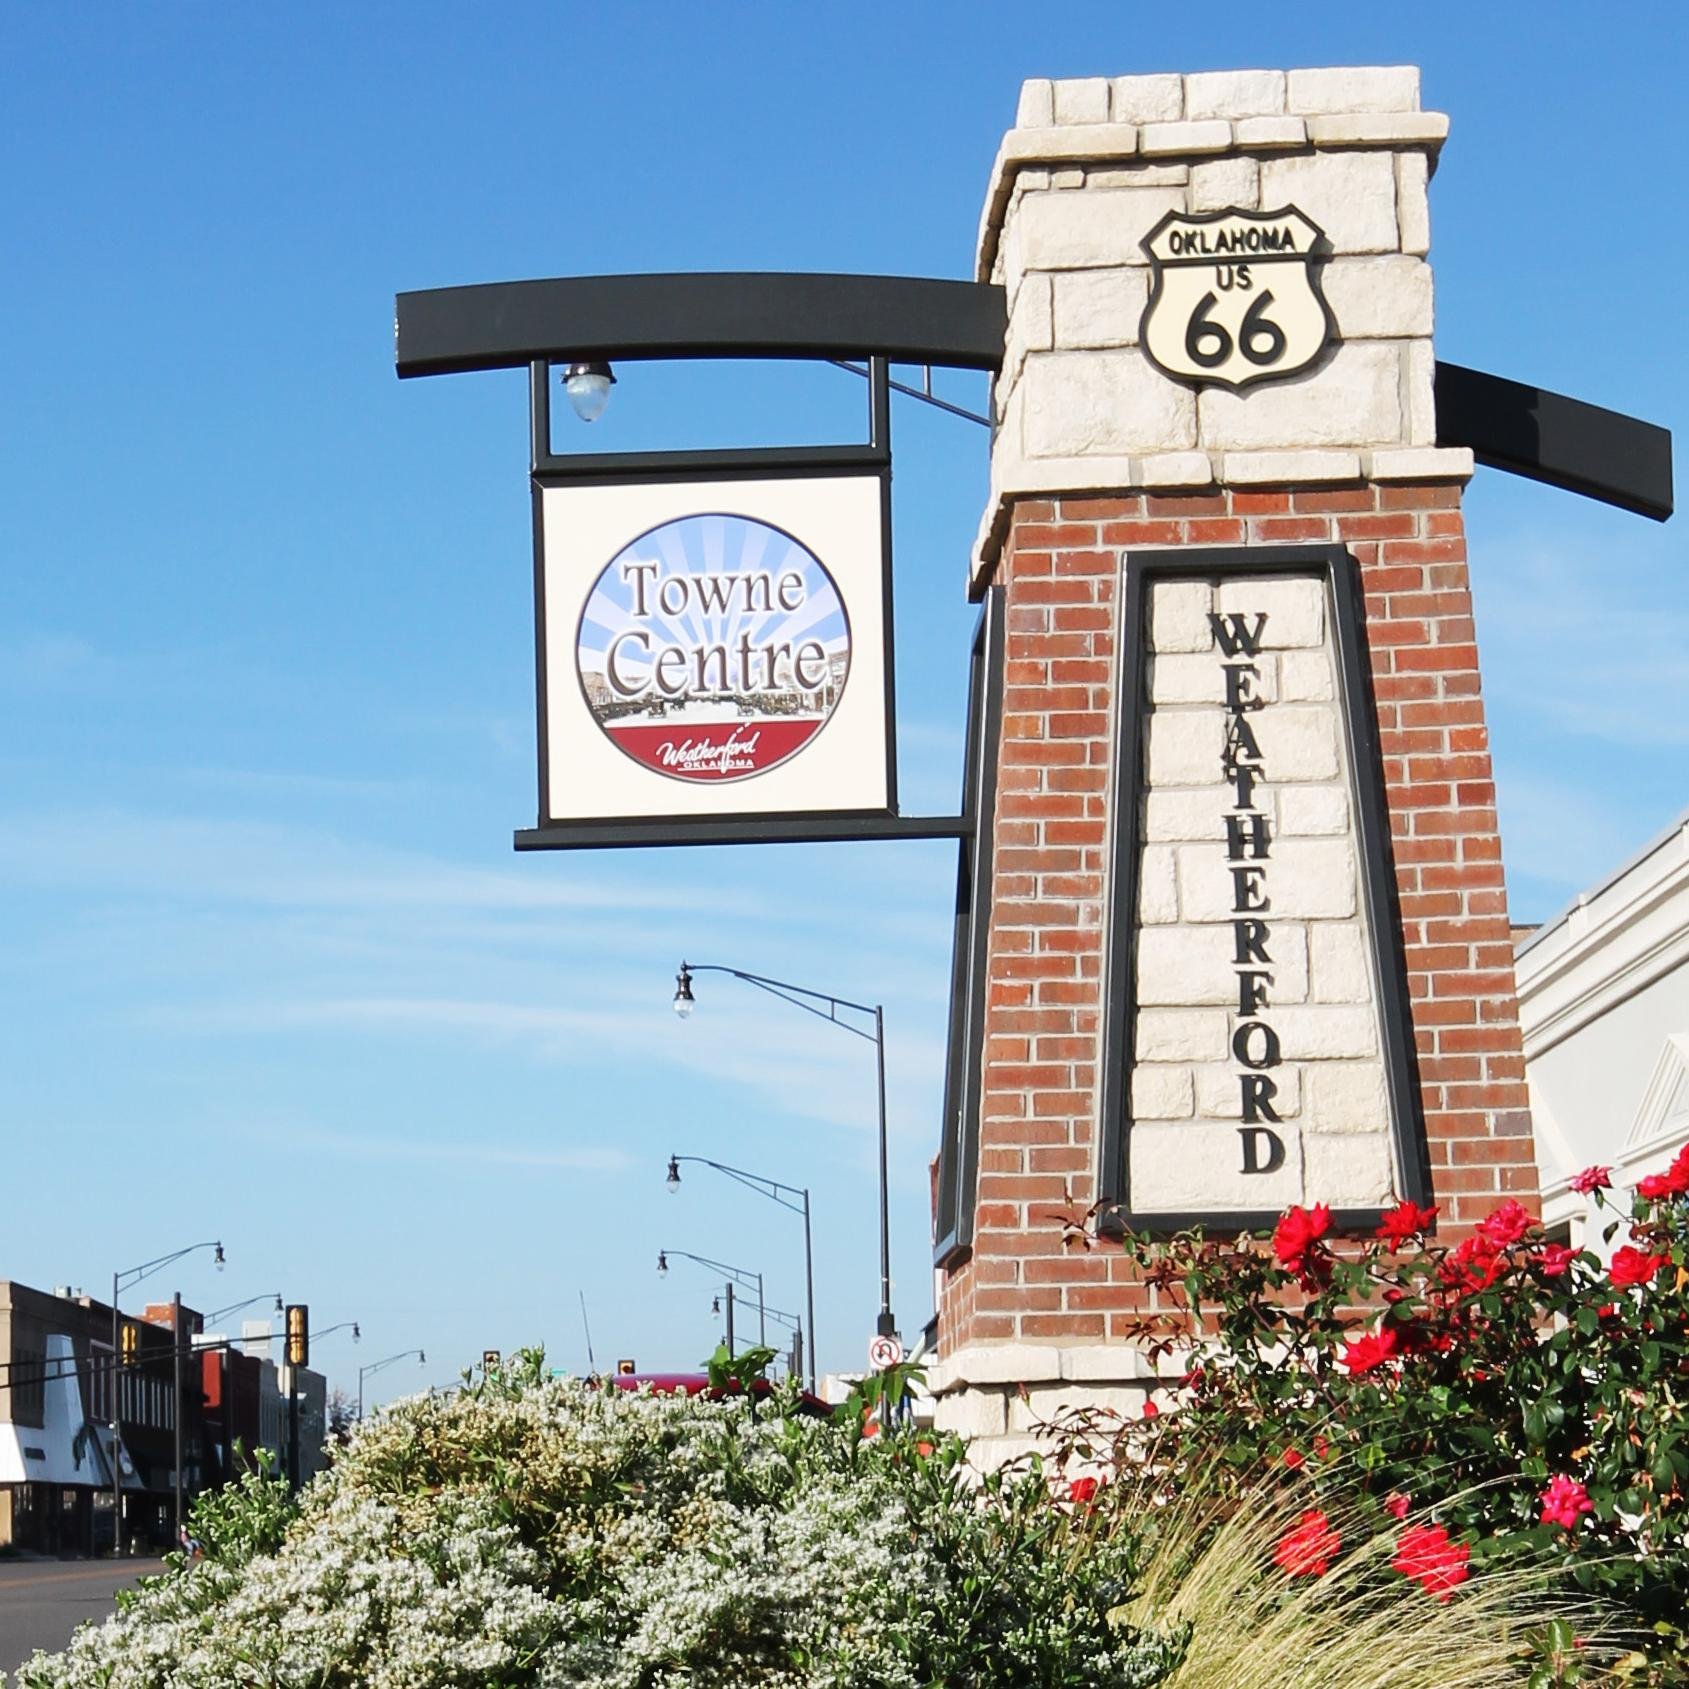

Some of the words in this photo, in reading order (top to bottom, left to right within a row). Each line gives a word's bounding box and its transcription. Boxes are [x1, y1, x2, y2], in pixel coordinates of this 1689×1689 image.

[1169, 227, 1296, 255] OKLAHOMA
[1217, 264, 1252, 290] US
[1185, 289, 1287, 368] 66
[623, 562, 805, 616] Towne
[606, 631, 827, 697] Centre
[656, 731, 760, 774] Weatherford
[1206, 612, 1286, 1175] WEATHERFORD
